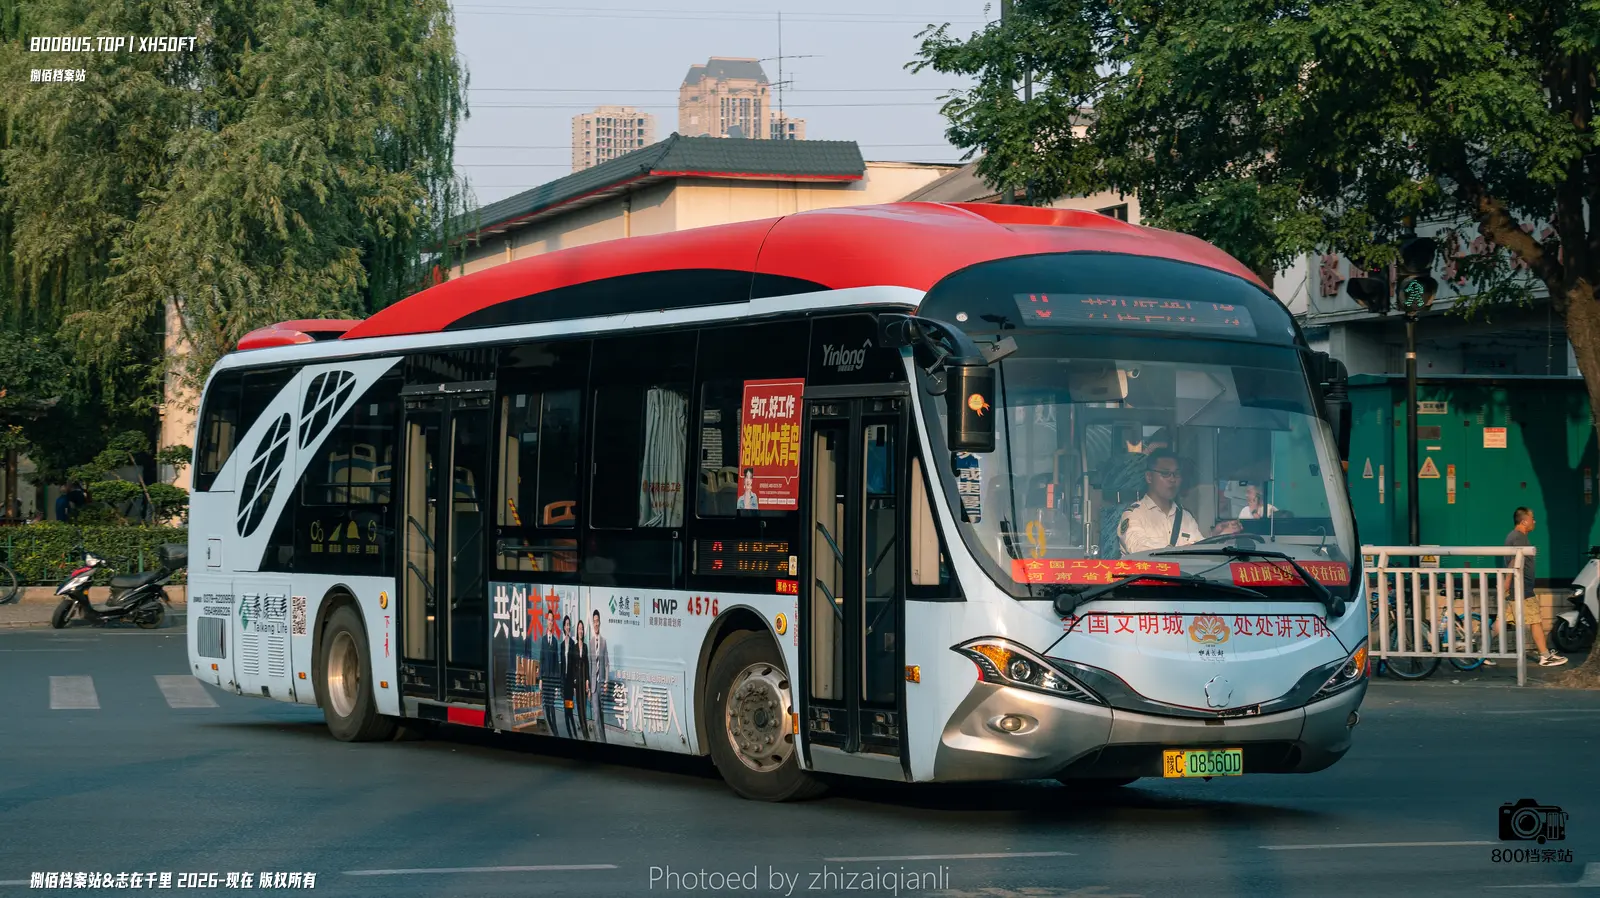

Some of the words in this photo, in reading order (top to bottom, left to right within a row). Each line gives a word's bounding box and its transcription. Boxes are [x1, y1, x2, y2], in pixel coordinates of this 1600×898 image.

[823, 344, 866, 370] Yinlong
[741, 422, 800, 467] 洛阳北大青鸟
[1025, 519, 1047, 559] 9
[1026, 560, 1172, 572] 全国工人先锋号
[652, 598, 678, 615] HWP
[687, 596, 719, 617] 4576
[1061, 610, 1185, 635] 全国文明城
[1233, 613, 1331, 638] 处处讲文明
[1190, 753, 1241, 773] 08560D
